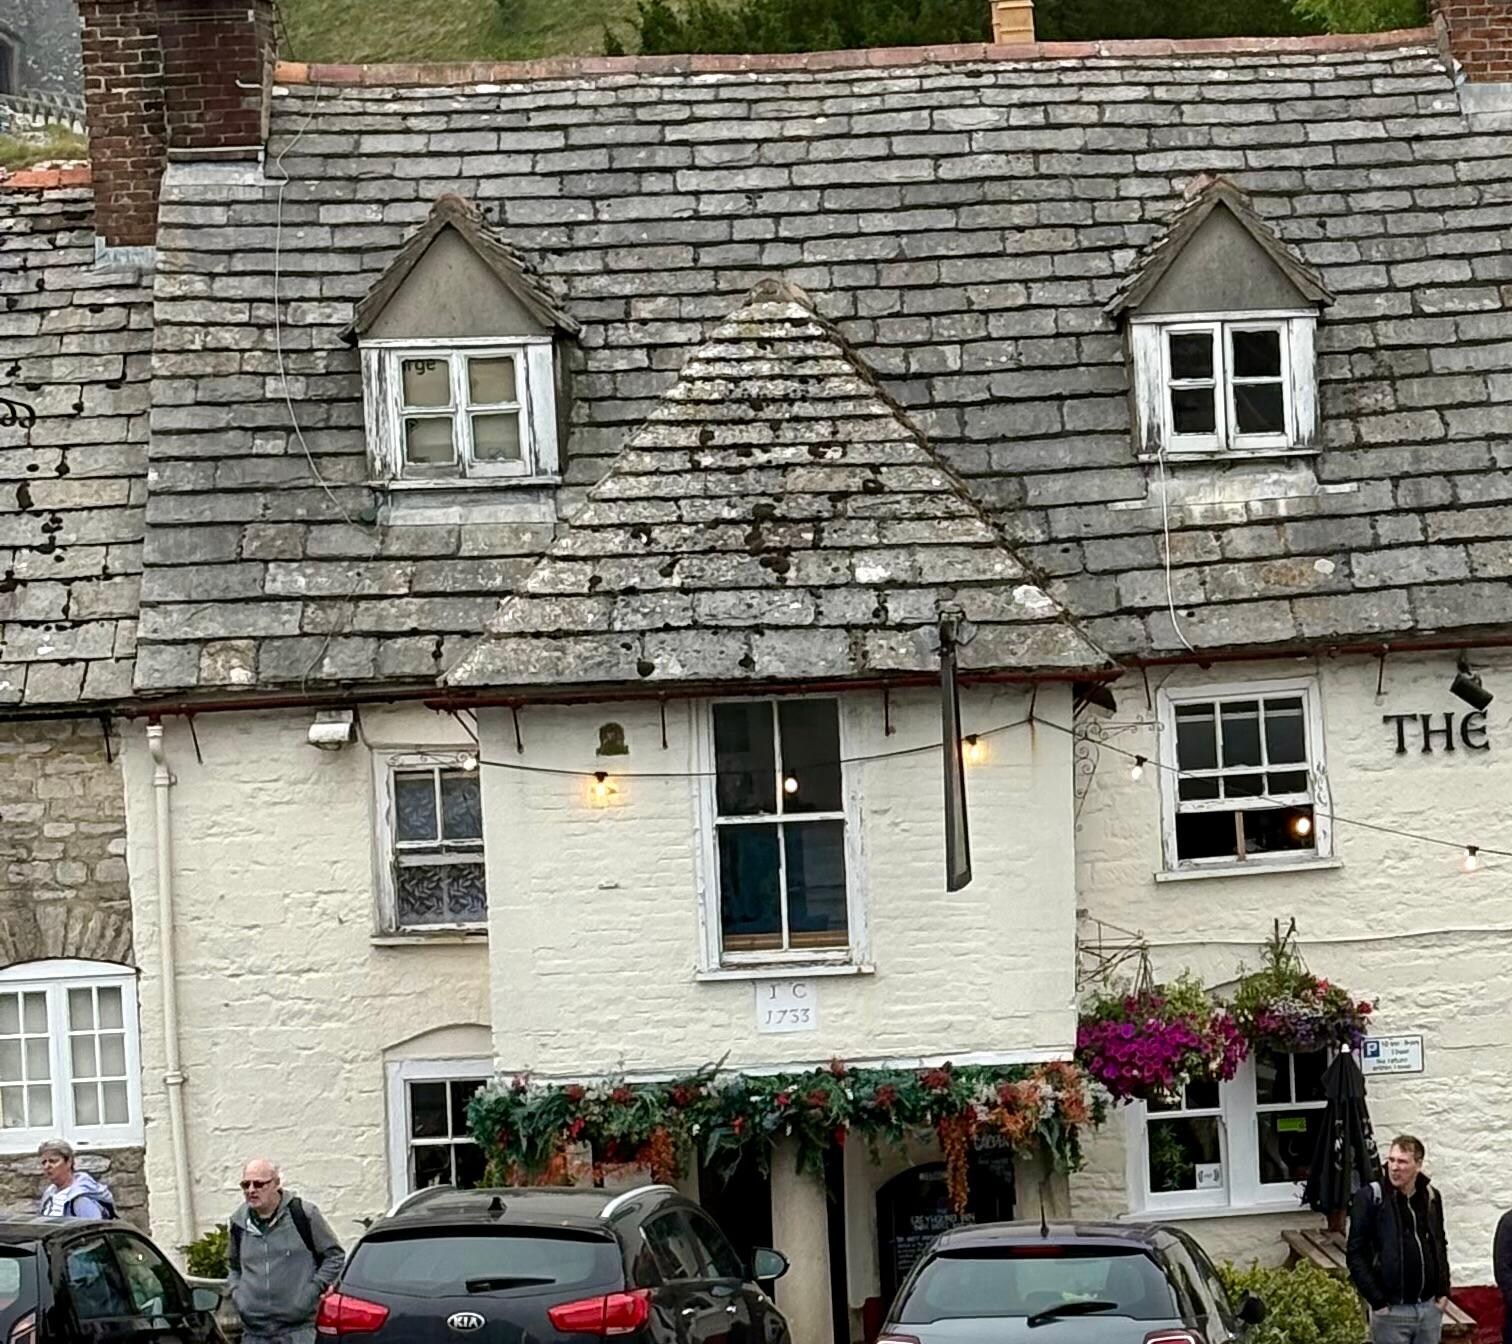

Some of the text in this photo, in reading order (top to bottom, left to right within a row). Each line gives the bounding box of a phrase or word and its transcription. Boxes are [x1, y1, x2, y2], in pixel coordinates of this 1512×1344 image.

[1383, 710, 1490, 754] THE
[766, 1008, 810, 1024] 1733
[453, 1316, 479, 1328] KIA
